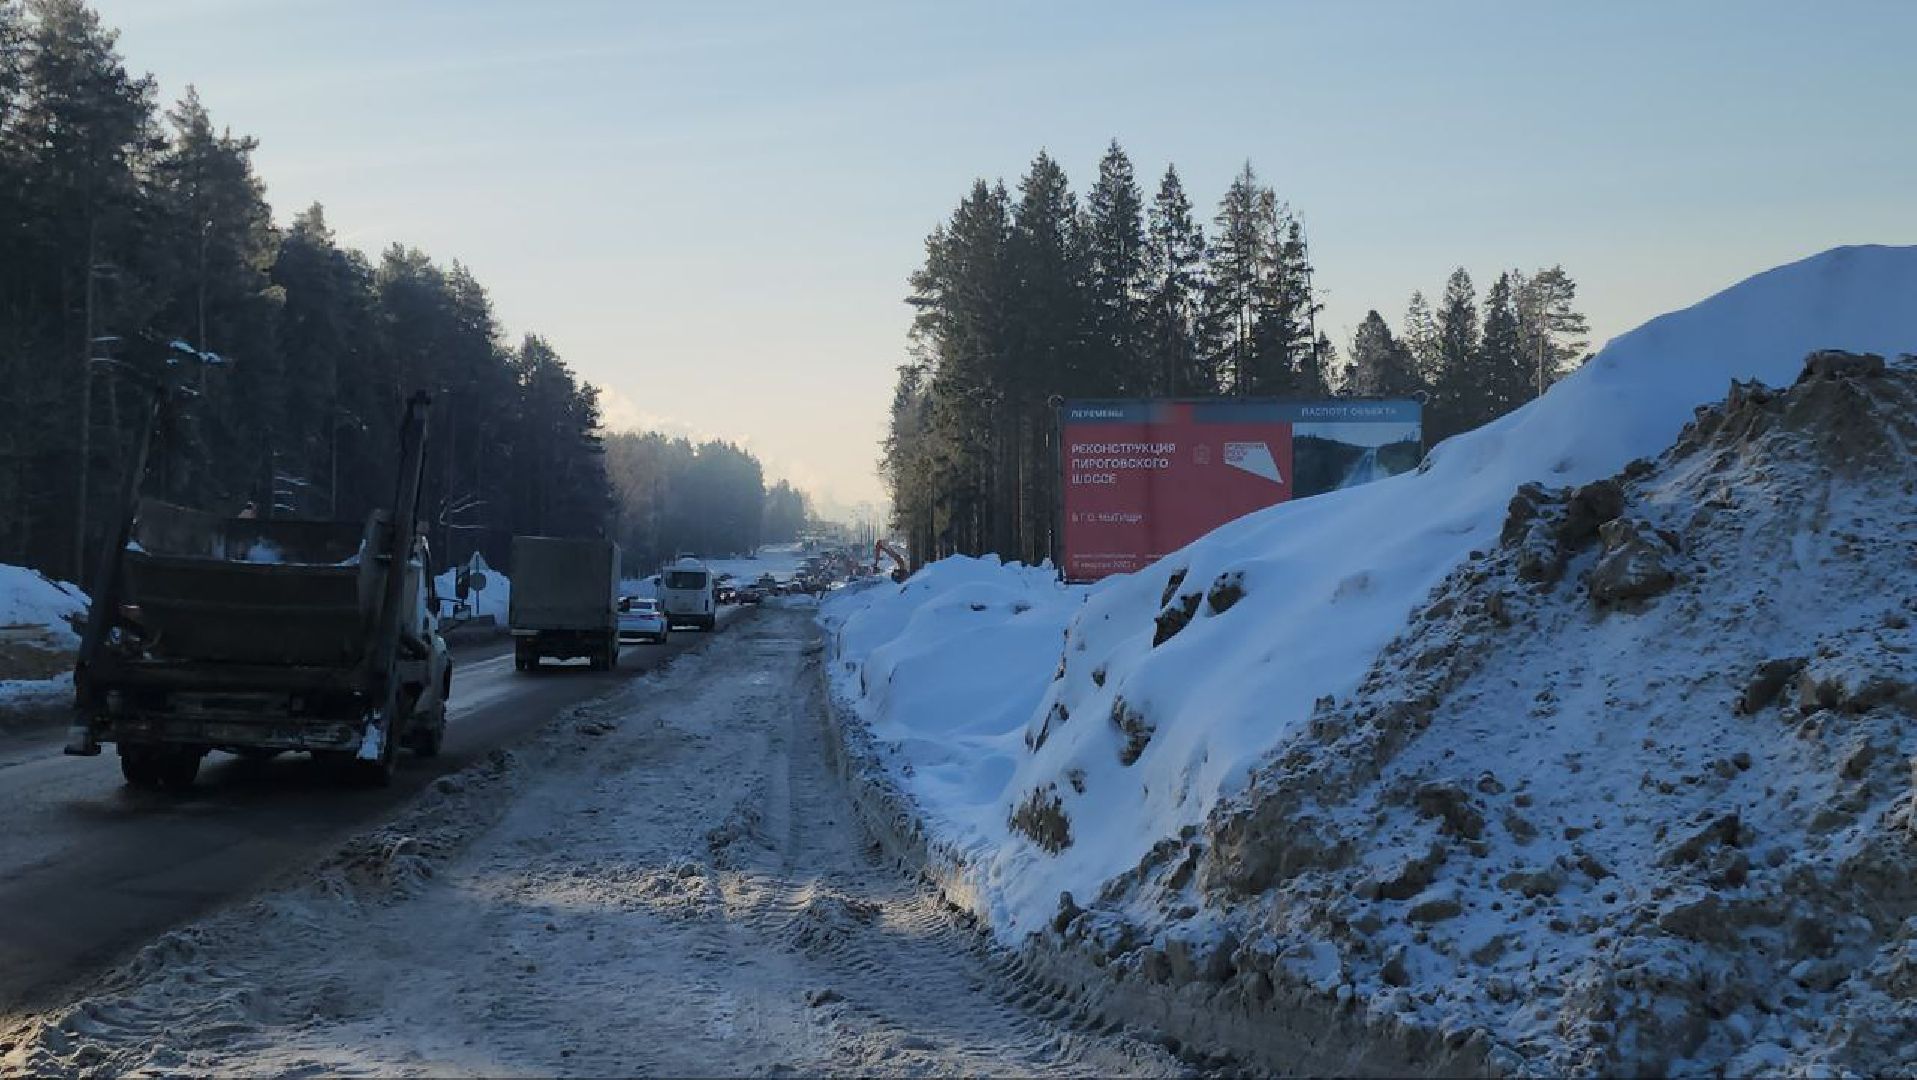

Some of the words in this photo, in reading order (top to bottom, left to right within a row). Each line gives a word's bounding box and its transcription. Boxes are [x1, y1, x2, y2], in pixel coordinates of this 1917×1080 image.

[1301, 407, 1347, 417] ПАСПОРТ
[1071, 443, 1176, 455] РЕКОНСТРУКЦИЯ
[1071, 458, 1169, 469] ПИРОГОВСКОГО
[1072, 473, 1117, 484] ШОССЕ
